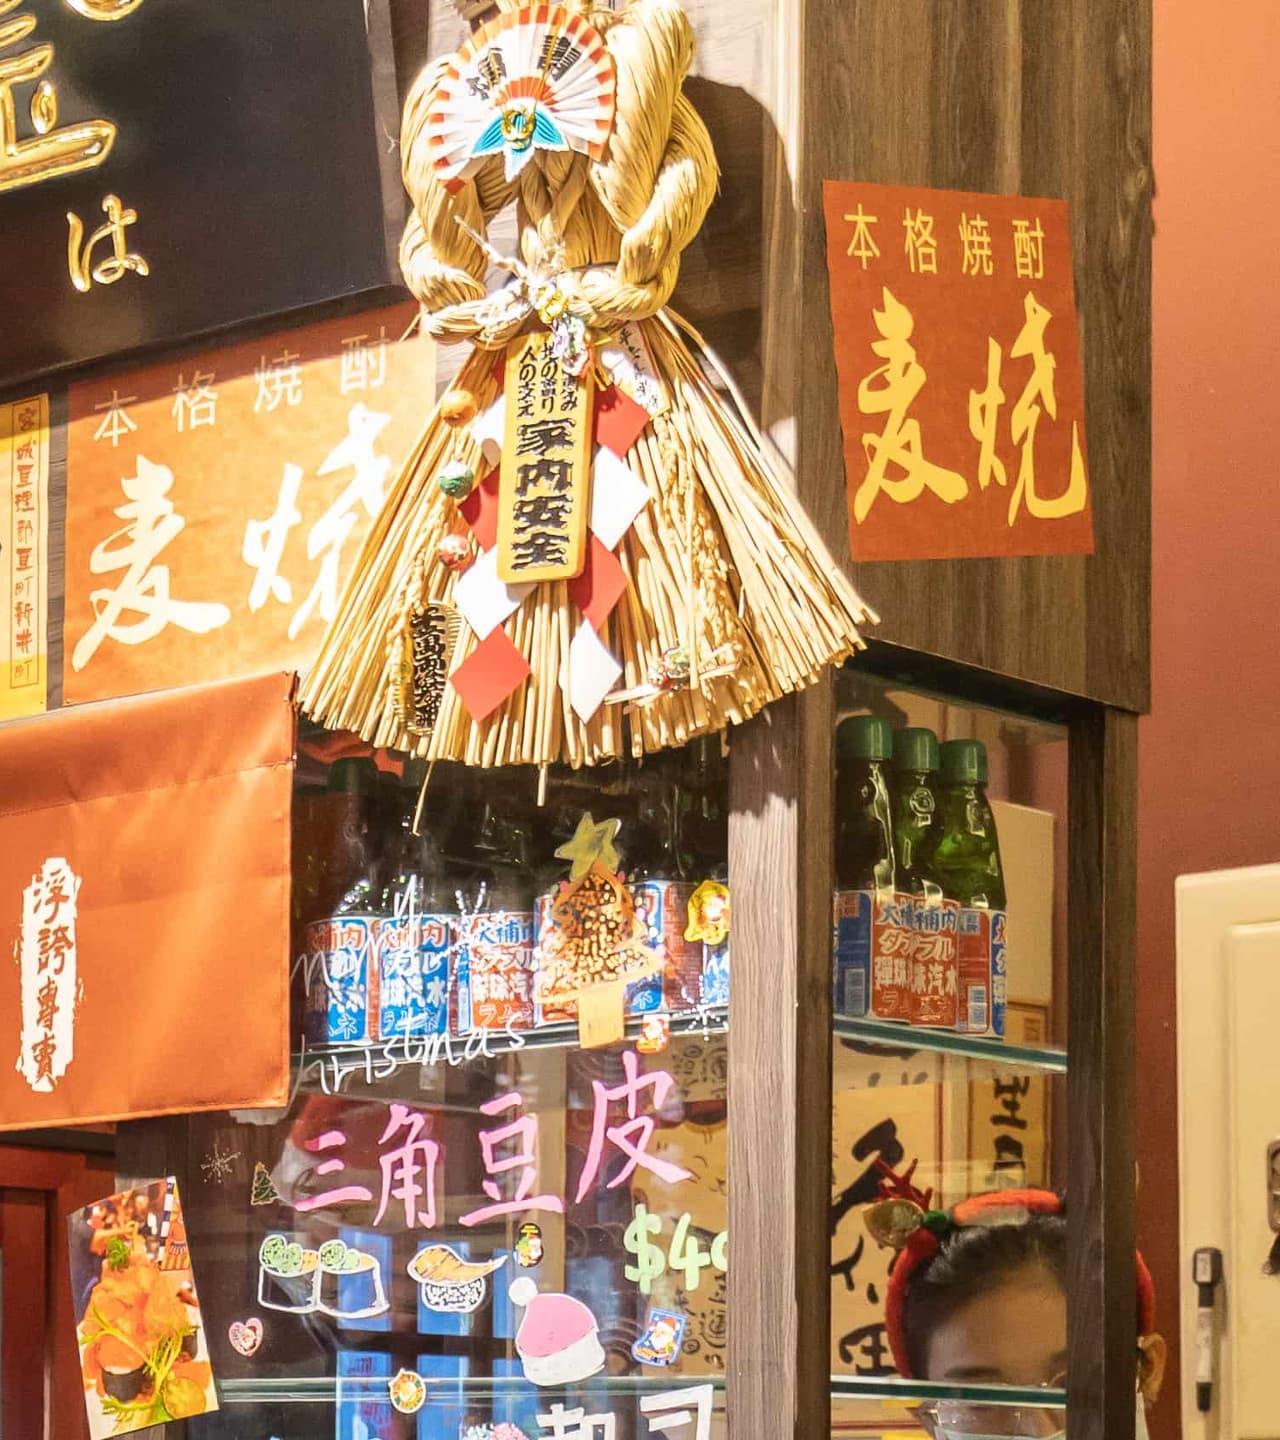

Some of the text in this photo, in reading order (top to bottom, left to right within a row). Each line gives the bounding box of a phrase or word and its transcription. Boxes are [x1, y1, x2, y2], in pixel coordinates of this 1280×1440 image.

[844, 203, 1045, 280] 本格焼酎
[93, 326, 388, 448] 本格焼酎
[295, 1050, 691, 1229] 三角豆皮
